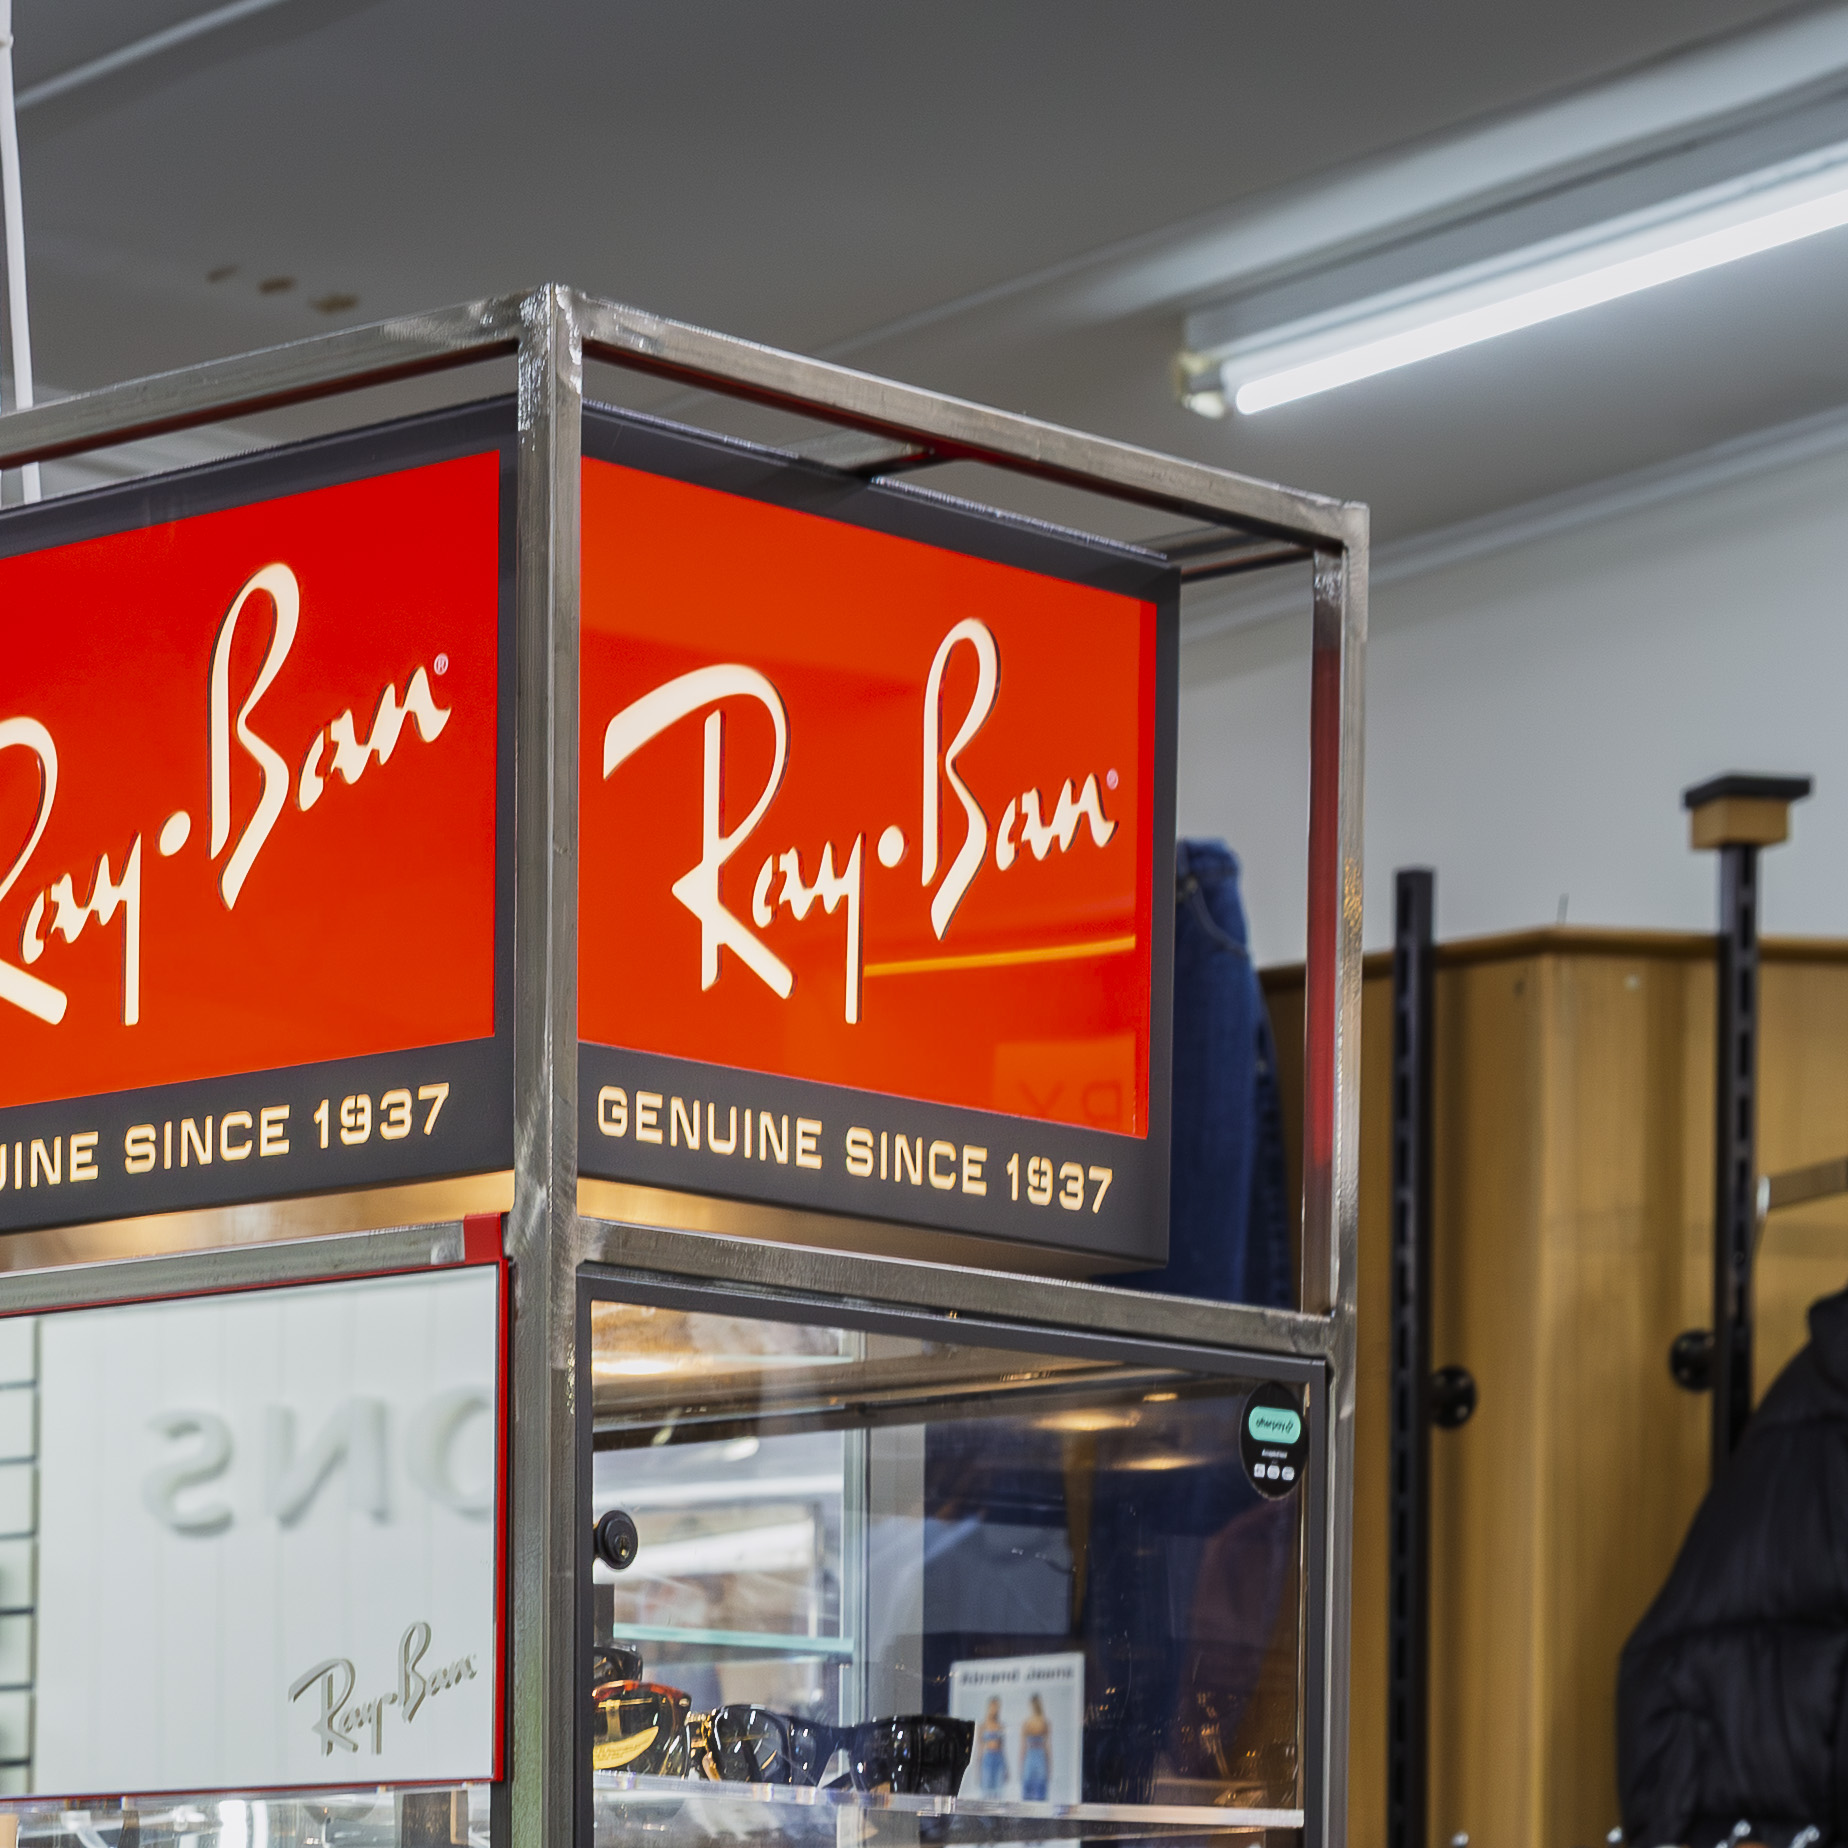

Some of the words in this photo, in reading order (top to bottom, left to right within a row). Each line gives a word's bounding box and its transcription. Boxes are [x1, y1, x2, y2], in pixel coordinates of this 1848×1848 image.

[124, 1106, 291, 1175] SINCE
[313, 1082, 451, 1149] 1937
[597, 1086, 823, 1169] GENUINE
[846, 1128, 988, 1197] SINCE
[1007, 1154, 1113, 1214] 1937
